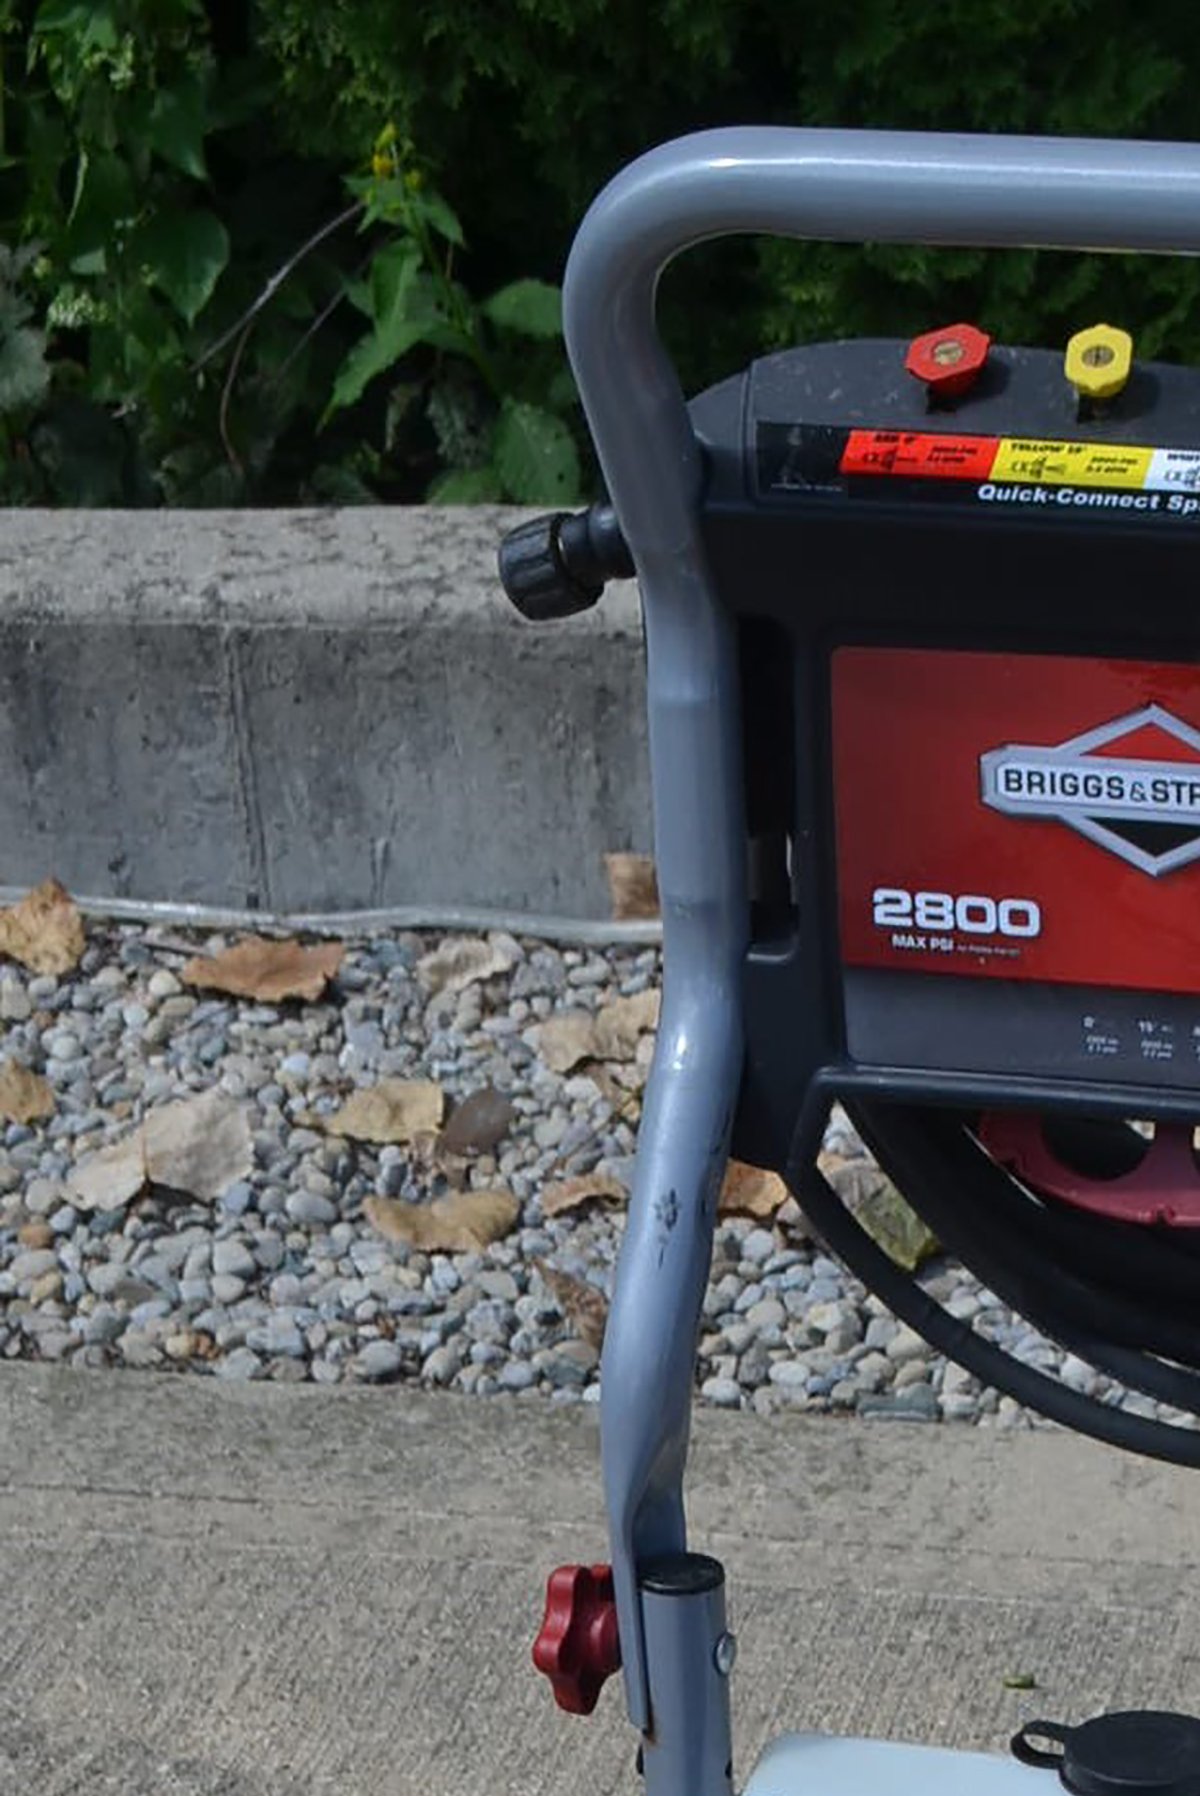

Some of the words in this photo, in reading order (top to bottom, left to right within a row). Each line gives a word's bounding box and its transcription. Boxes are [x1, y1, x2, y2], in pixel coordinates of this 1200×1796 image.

[977, 483, 1158, 510] Quick-Connect
[872, 887, 1041, 937] 2800
[891, 934, 927, 949] MAX
